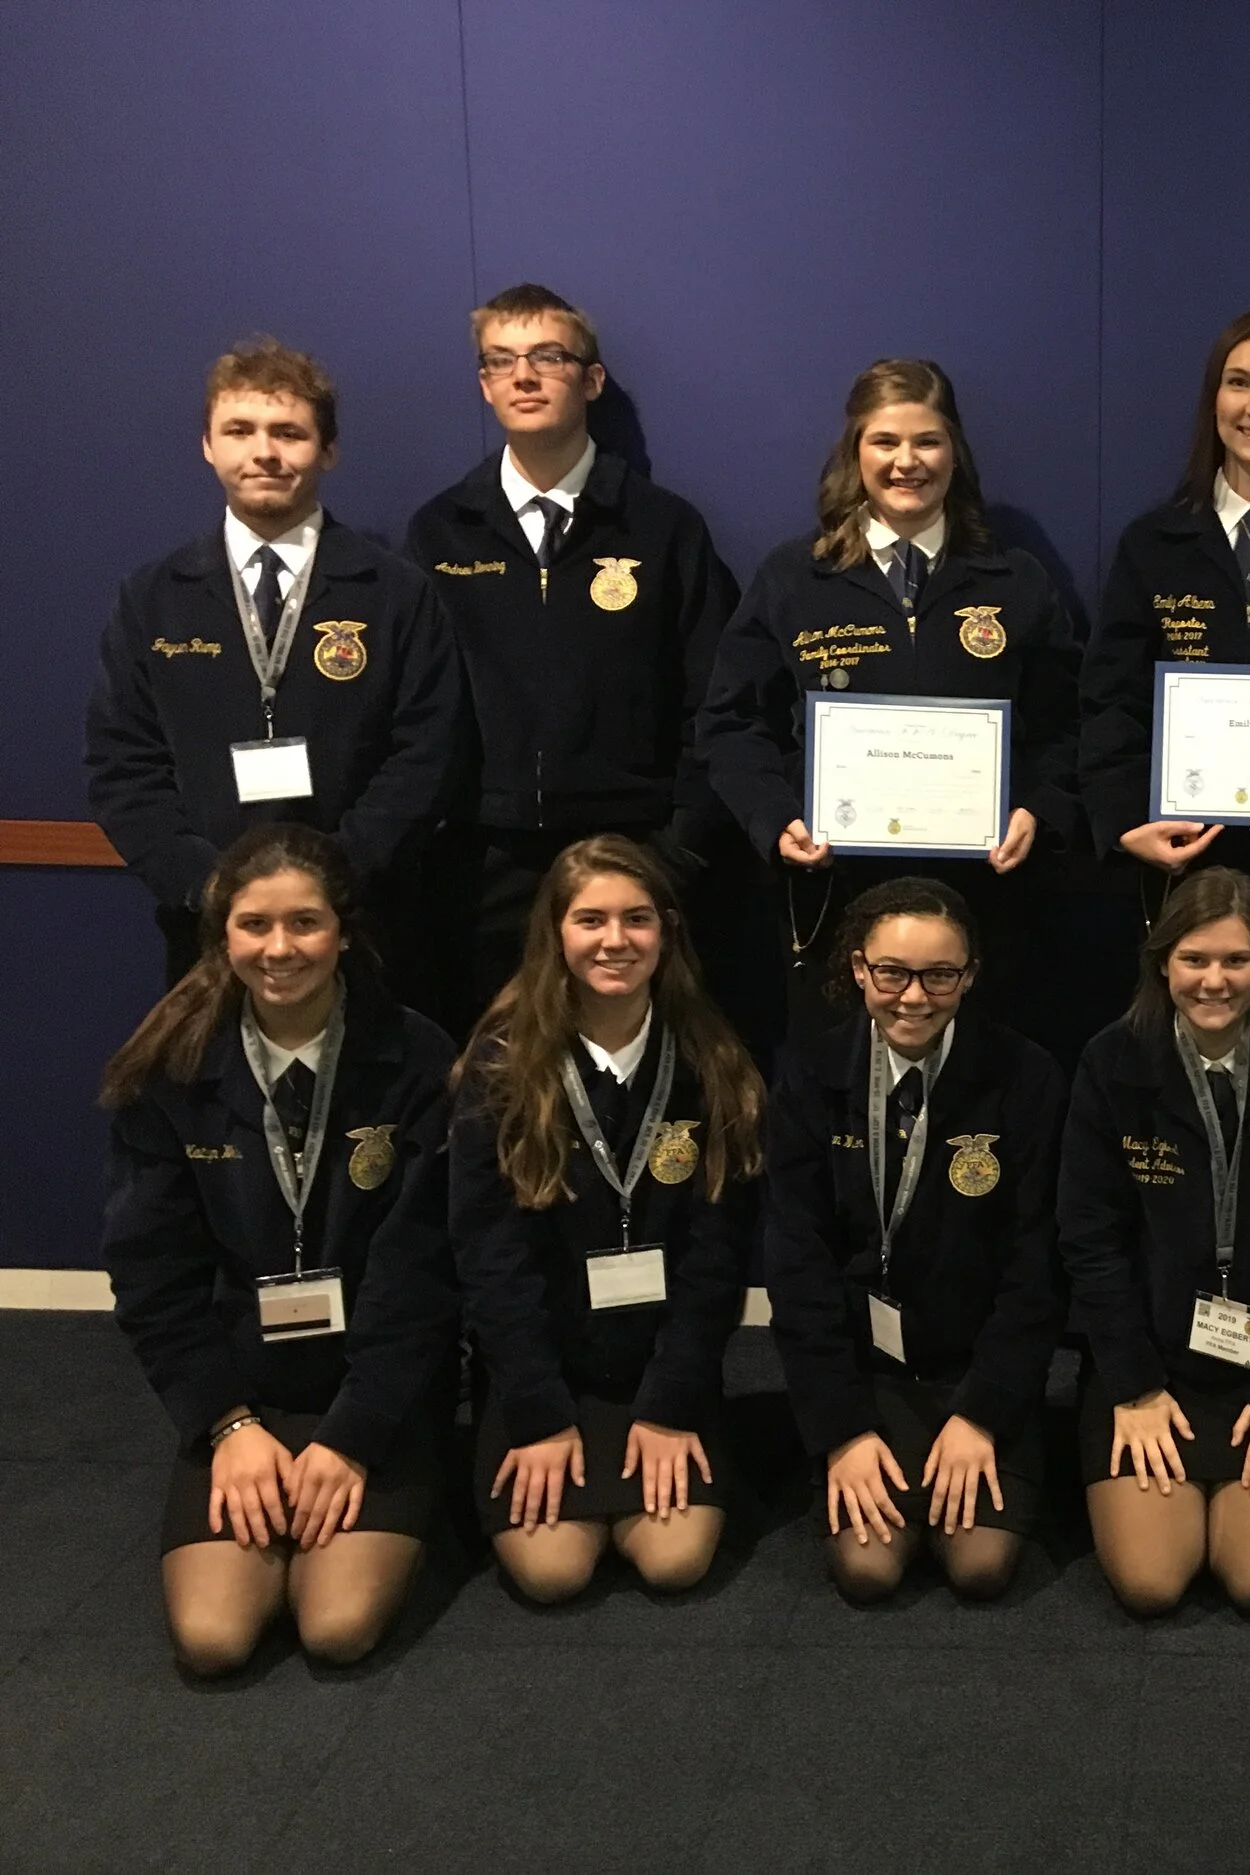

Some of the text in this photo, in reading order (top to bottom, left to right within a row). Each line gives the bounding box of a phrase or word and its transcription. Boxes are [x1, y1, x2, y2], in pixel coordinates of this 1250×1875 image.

[866, 748, 954, 761] Allison McCumons
[1218, 1312, 1237, 1324] 2019
[1197, 1320, 1220, 1333] MACY
